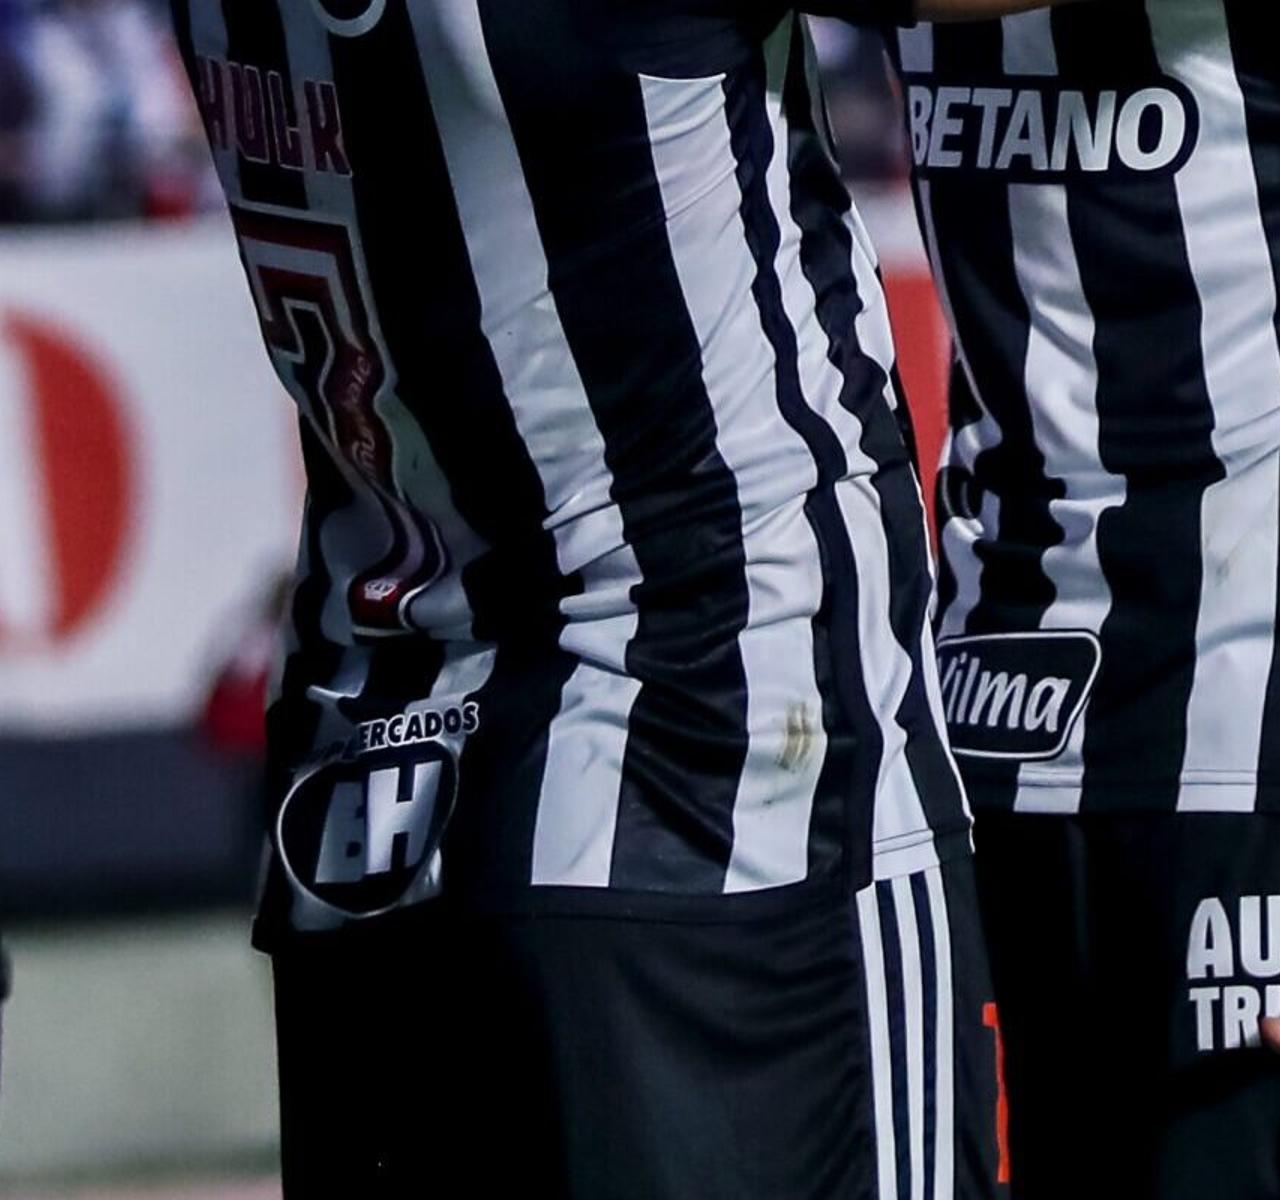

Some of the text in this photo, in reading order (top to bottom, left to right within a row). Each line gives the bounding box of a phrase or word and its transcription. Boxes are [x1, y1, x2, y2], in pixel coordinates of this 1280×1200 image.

[194, 56, 353, 176] HULK
[909, 87, 1185, 171] BETANO
[315, 760, 442, 883] BH
